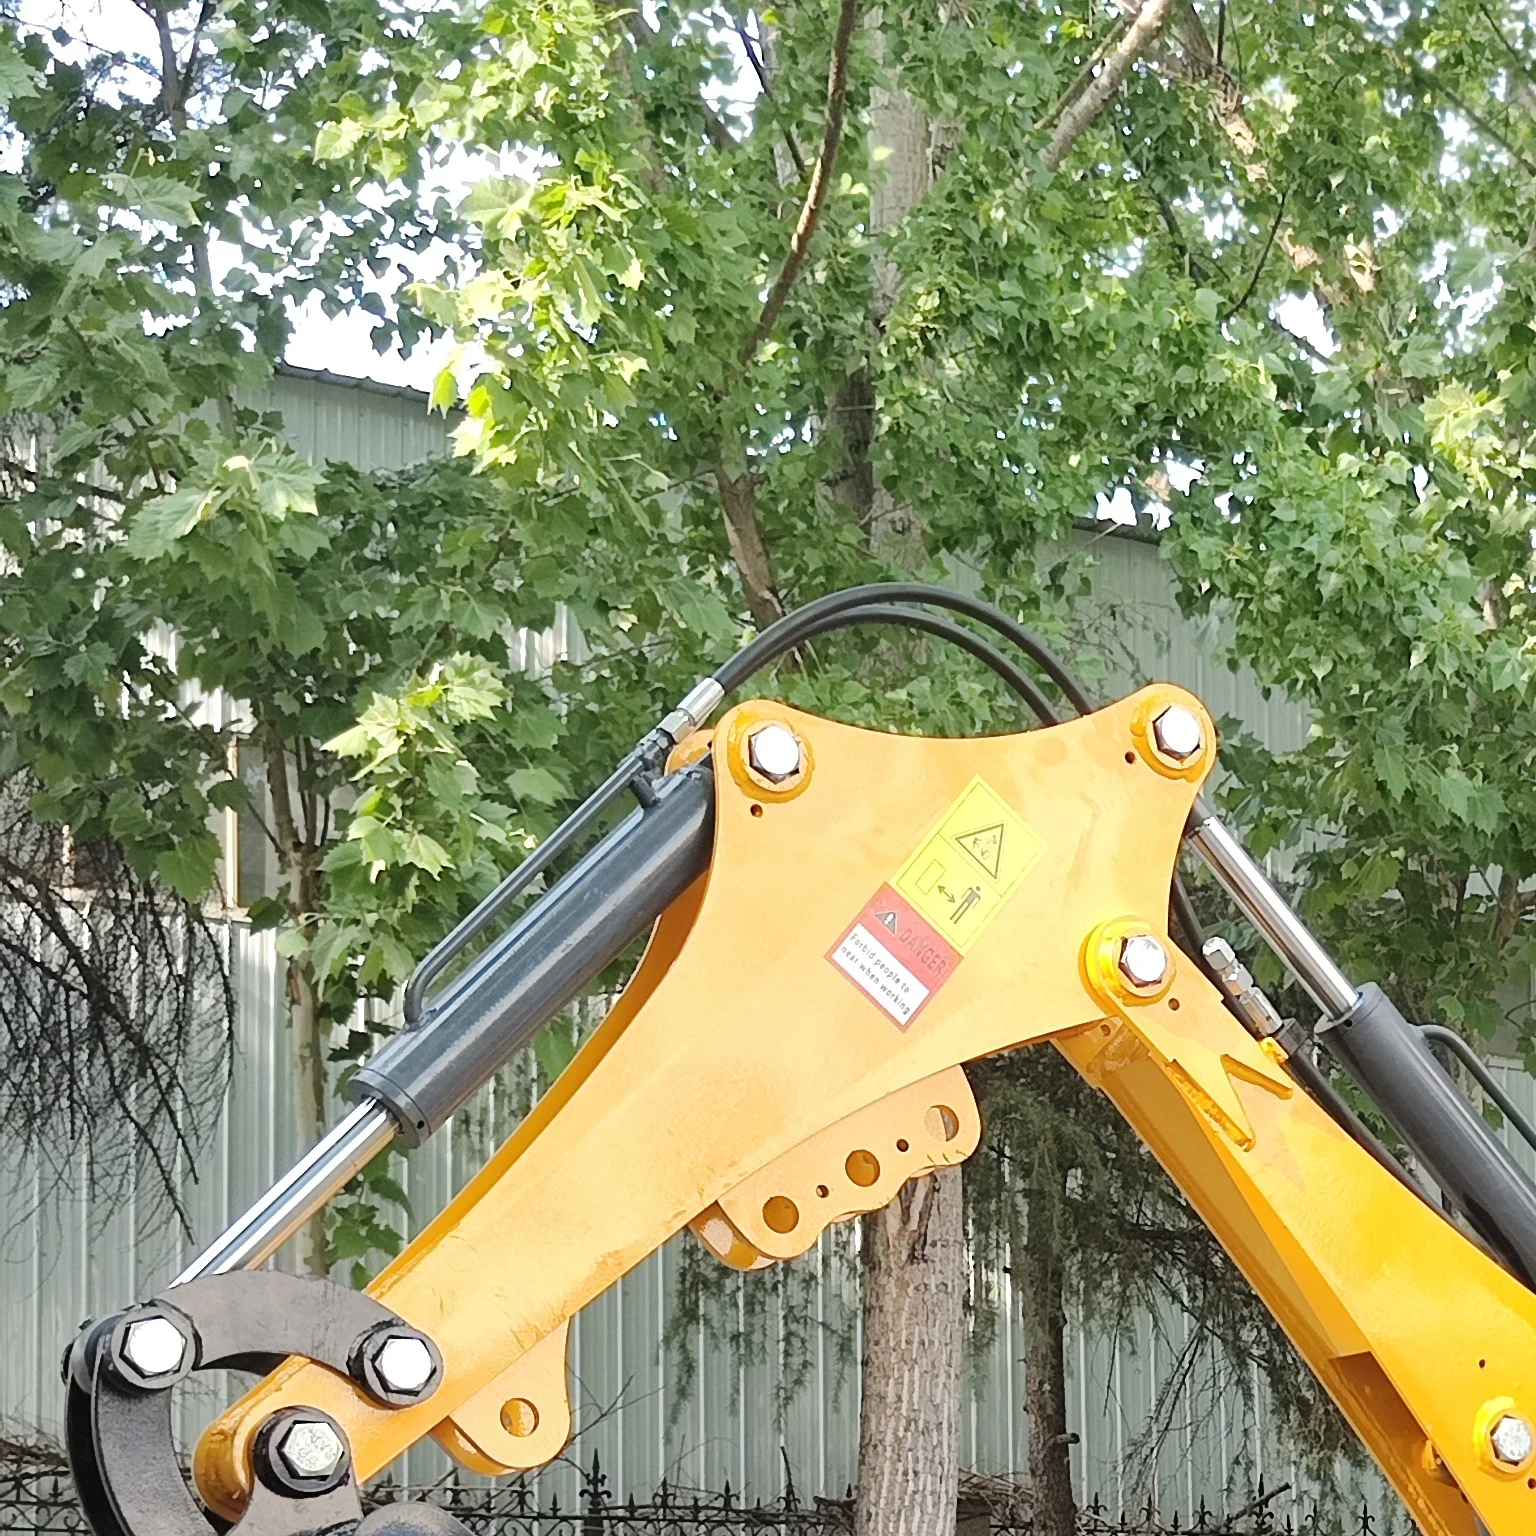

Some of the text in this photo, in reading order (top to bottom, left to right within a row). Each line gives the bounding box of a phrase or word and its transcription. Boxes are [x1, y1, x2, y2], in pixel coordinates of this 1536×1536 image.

[841, 946, 911, 1015] near when working
[850, 933, 910, 994] Forbid people to
[899, 926, 947, 975] DANGER
